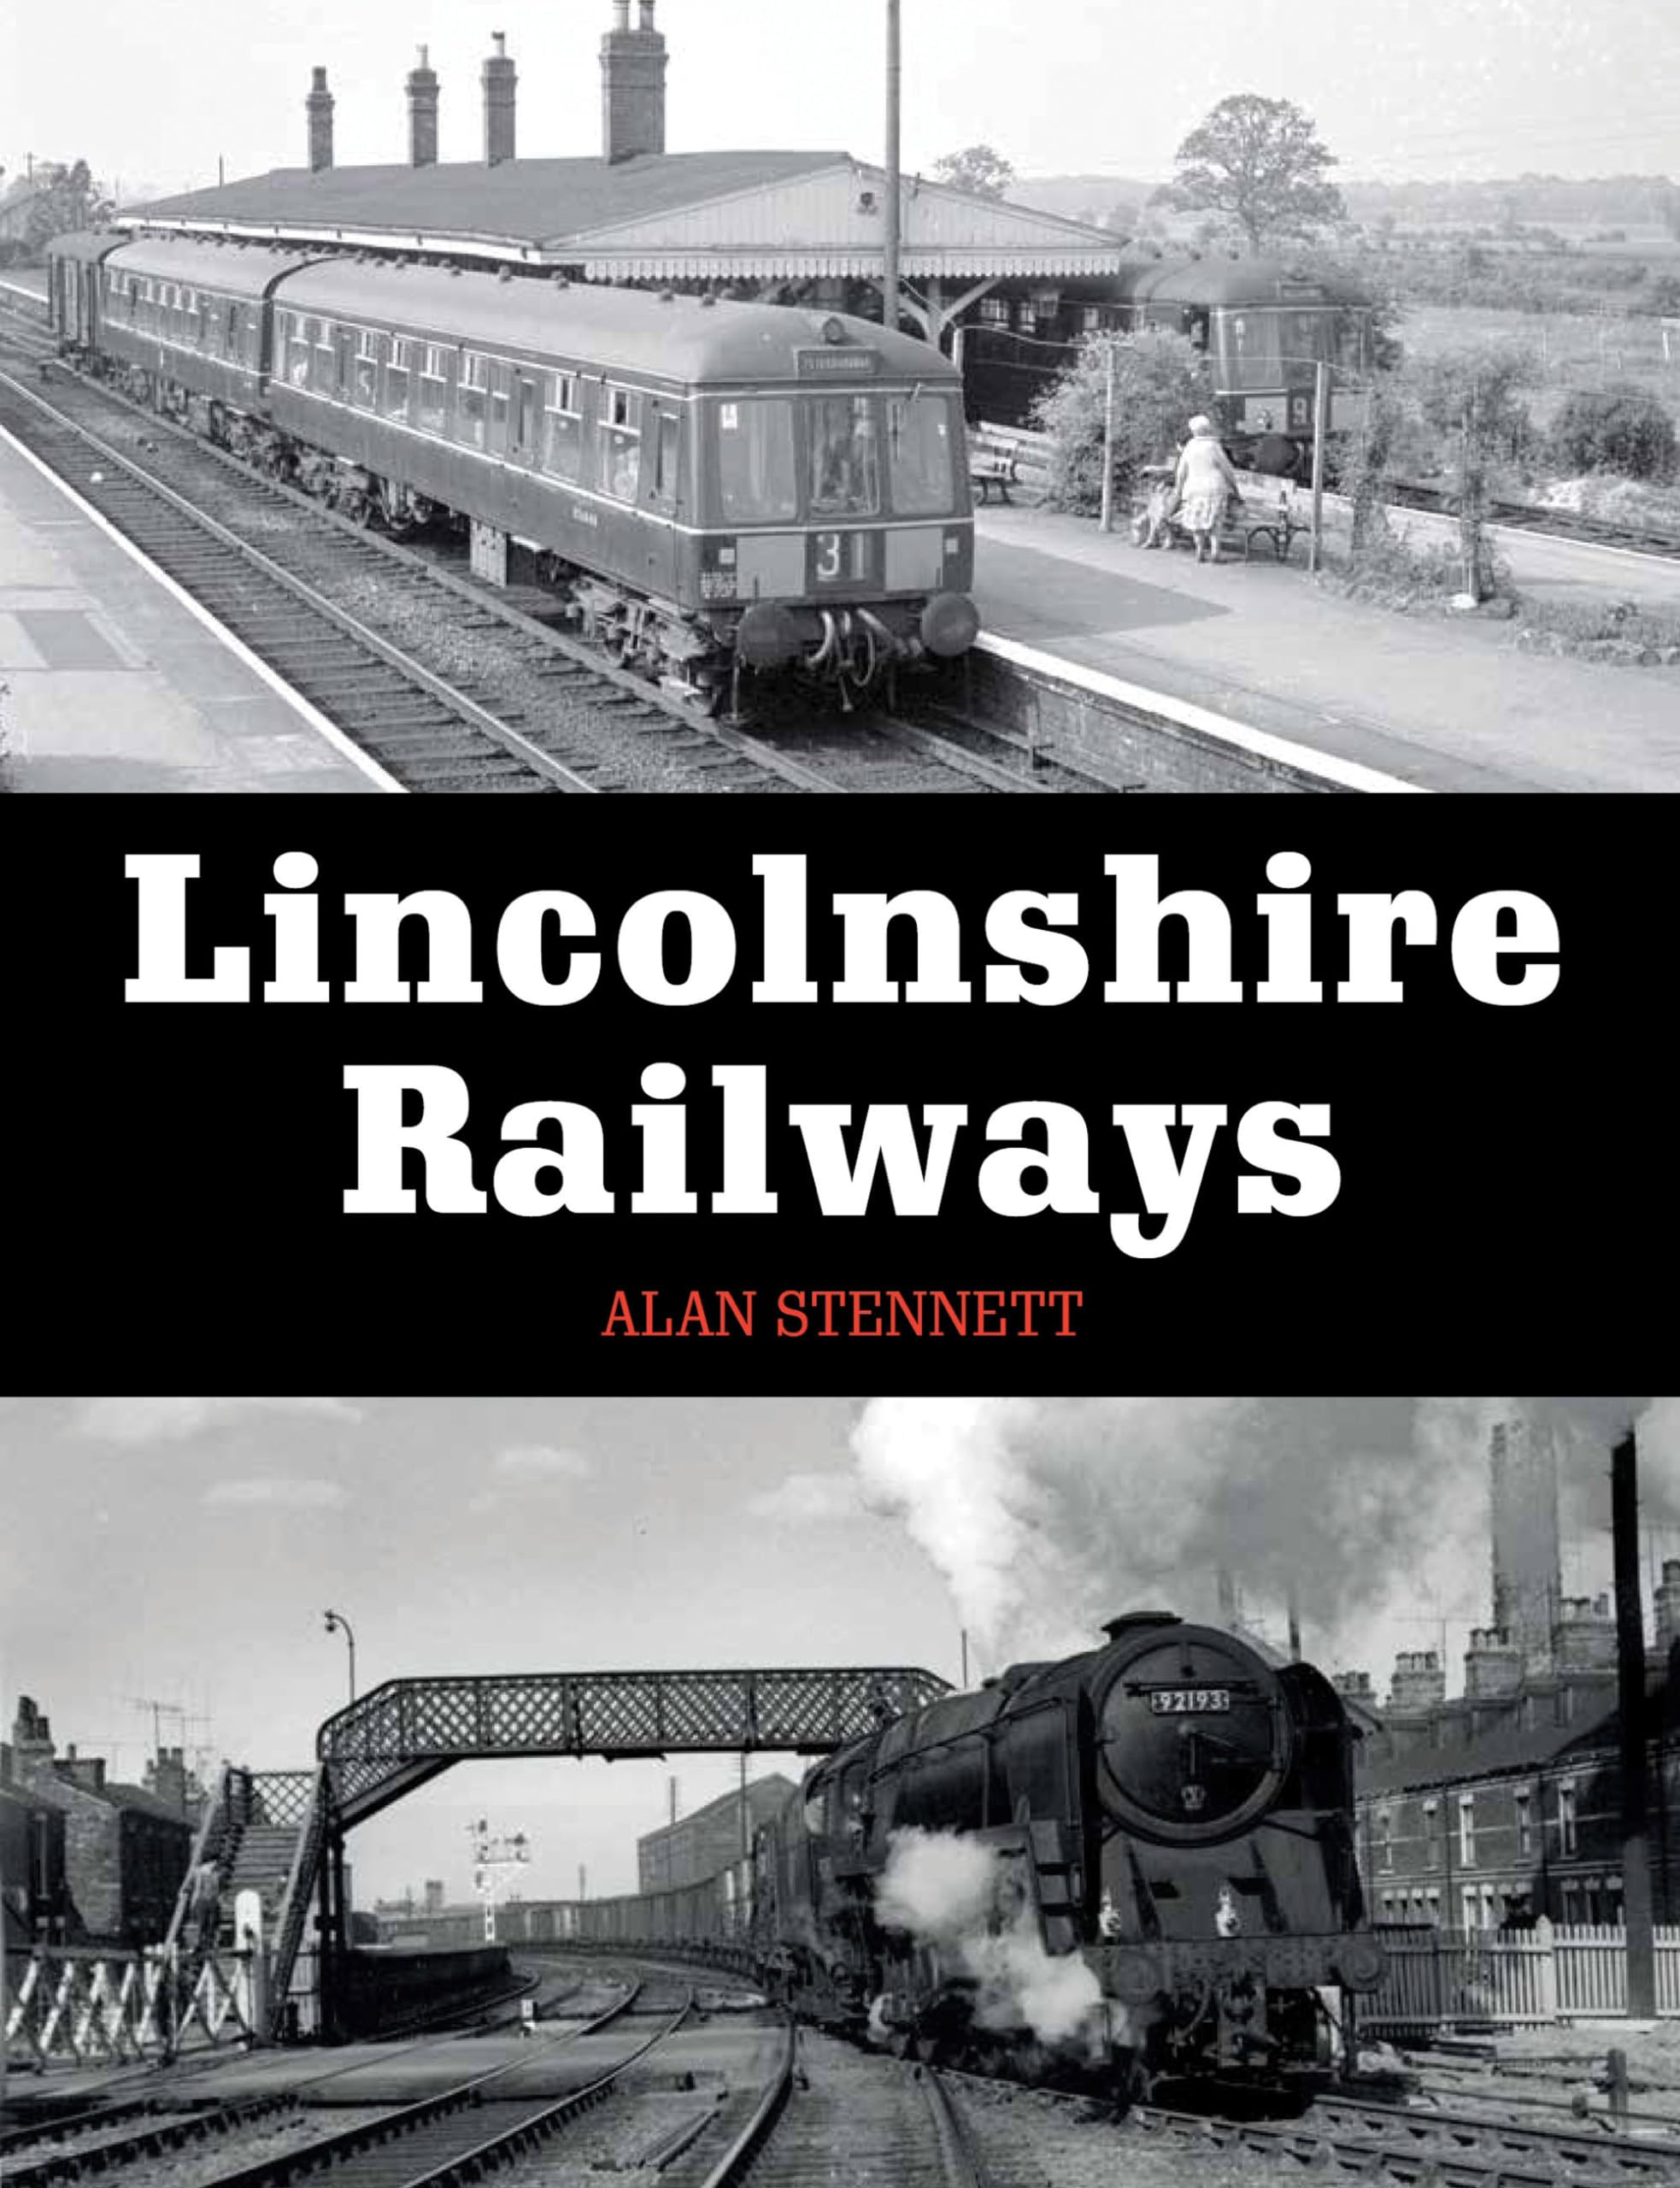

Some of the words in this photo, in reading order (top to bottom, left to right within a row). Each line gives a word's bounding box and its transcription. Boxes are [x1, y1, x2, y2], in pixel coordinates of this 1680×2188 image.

[125, 852, 1560, 1006] Lincolnshire
[344, 1062, 1341, 1258] Railways
[602, 1291, 756, 1337] ALAN
[778, 1291, 1083, 1337] STENNETT
[1160, 1691, 1223, 1710] 92193
